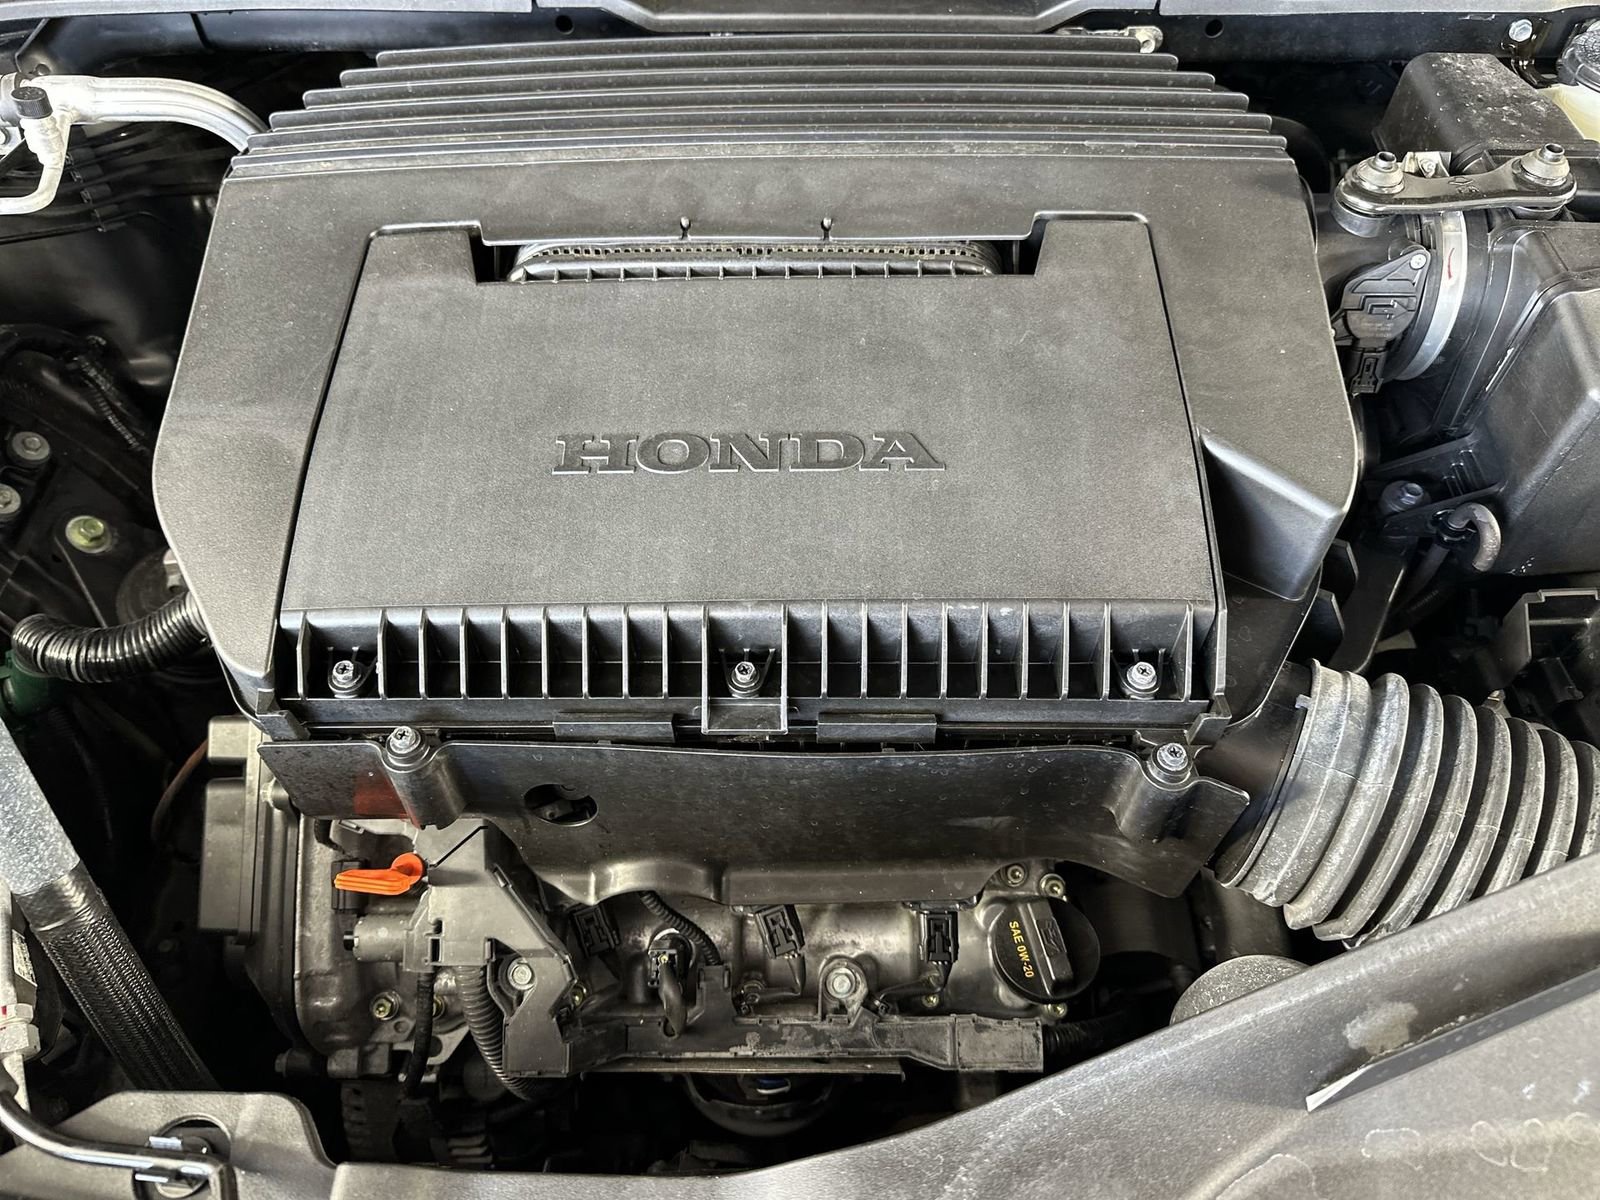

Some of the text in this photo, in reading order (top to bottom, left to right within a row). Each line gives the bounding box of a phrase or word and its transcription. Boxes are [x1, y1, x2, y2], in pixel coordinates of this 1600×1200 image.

[551, 431, 947, 475] HONDA
[1008, 920, 1035, 978] SAE 0W-20
